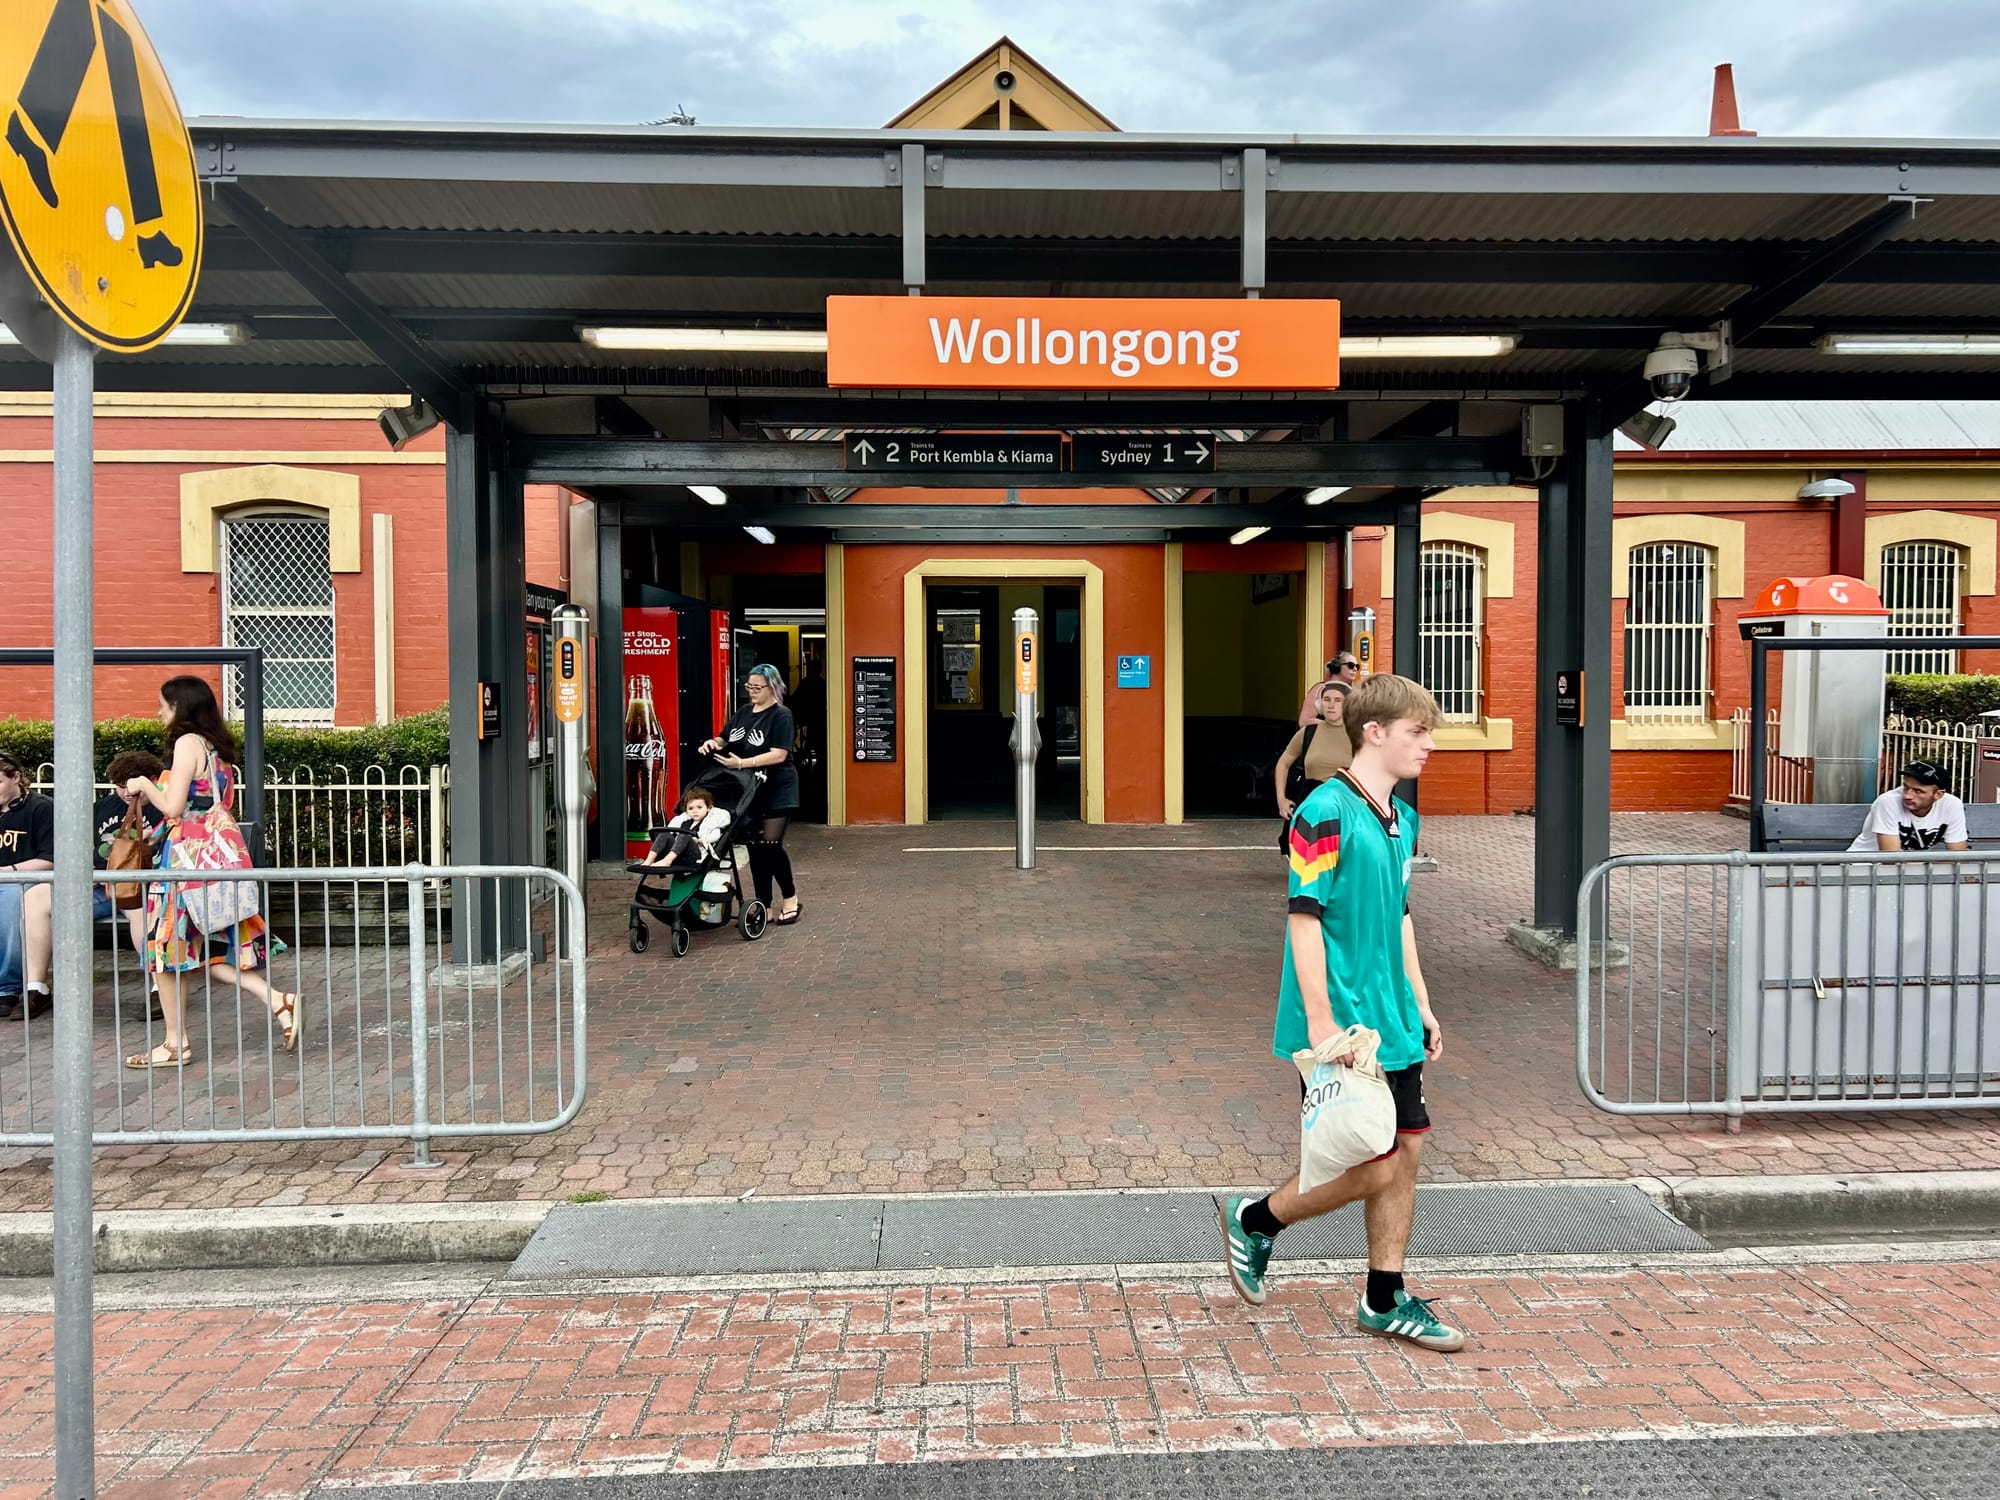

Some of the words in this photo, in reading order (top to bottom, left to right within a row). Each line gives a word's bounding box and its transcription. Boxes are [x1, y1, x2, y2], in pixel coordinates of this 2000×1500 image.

[928, 317, 1241, 378] Wollongong
[886, 442, 900, 463] 2
[910, 449, 940, 463] Port
[943, 449, 995, 463] Kembla
[997, 449, 1009, 463] &
[1011, 449, 1054, 463] Kiama
[1101, 449, 1152, 466] Sydney
[1163, 442, 1175, 463] 1
[535, 592, 546, 612] your
[633, 638, 671, 648] COLD
[637, 630, 663, 639] Stop...
